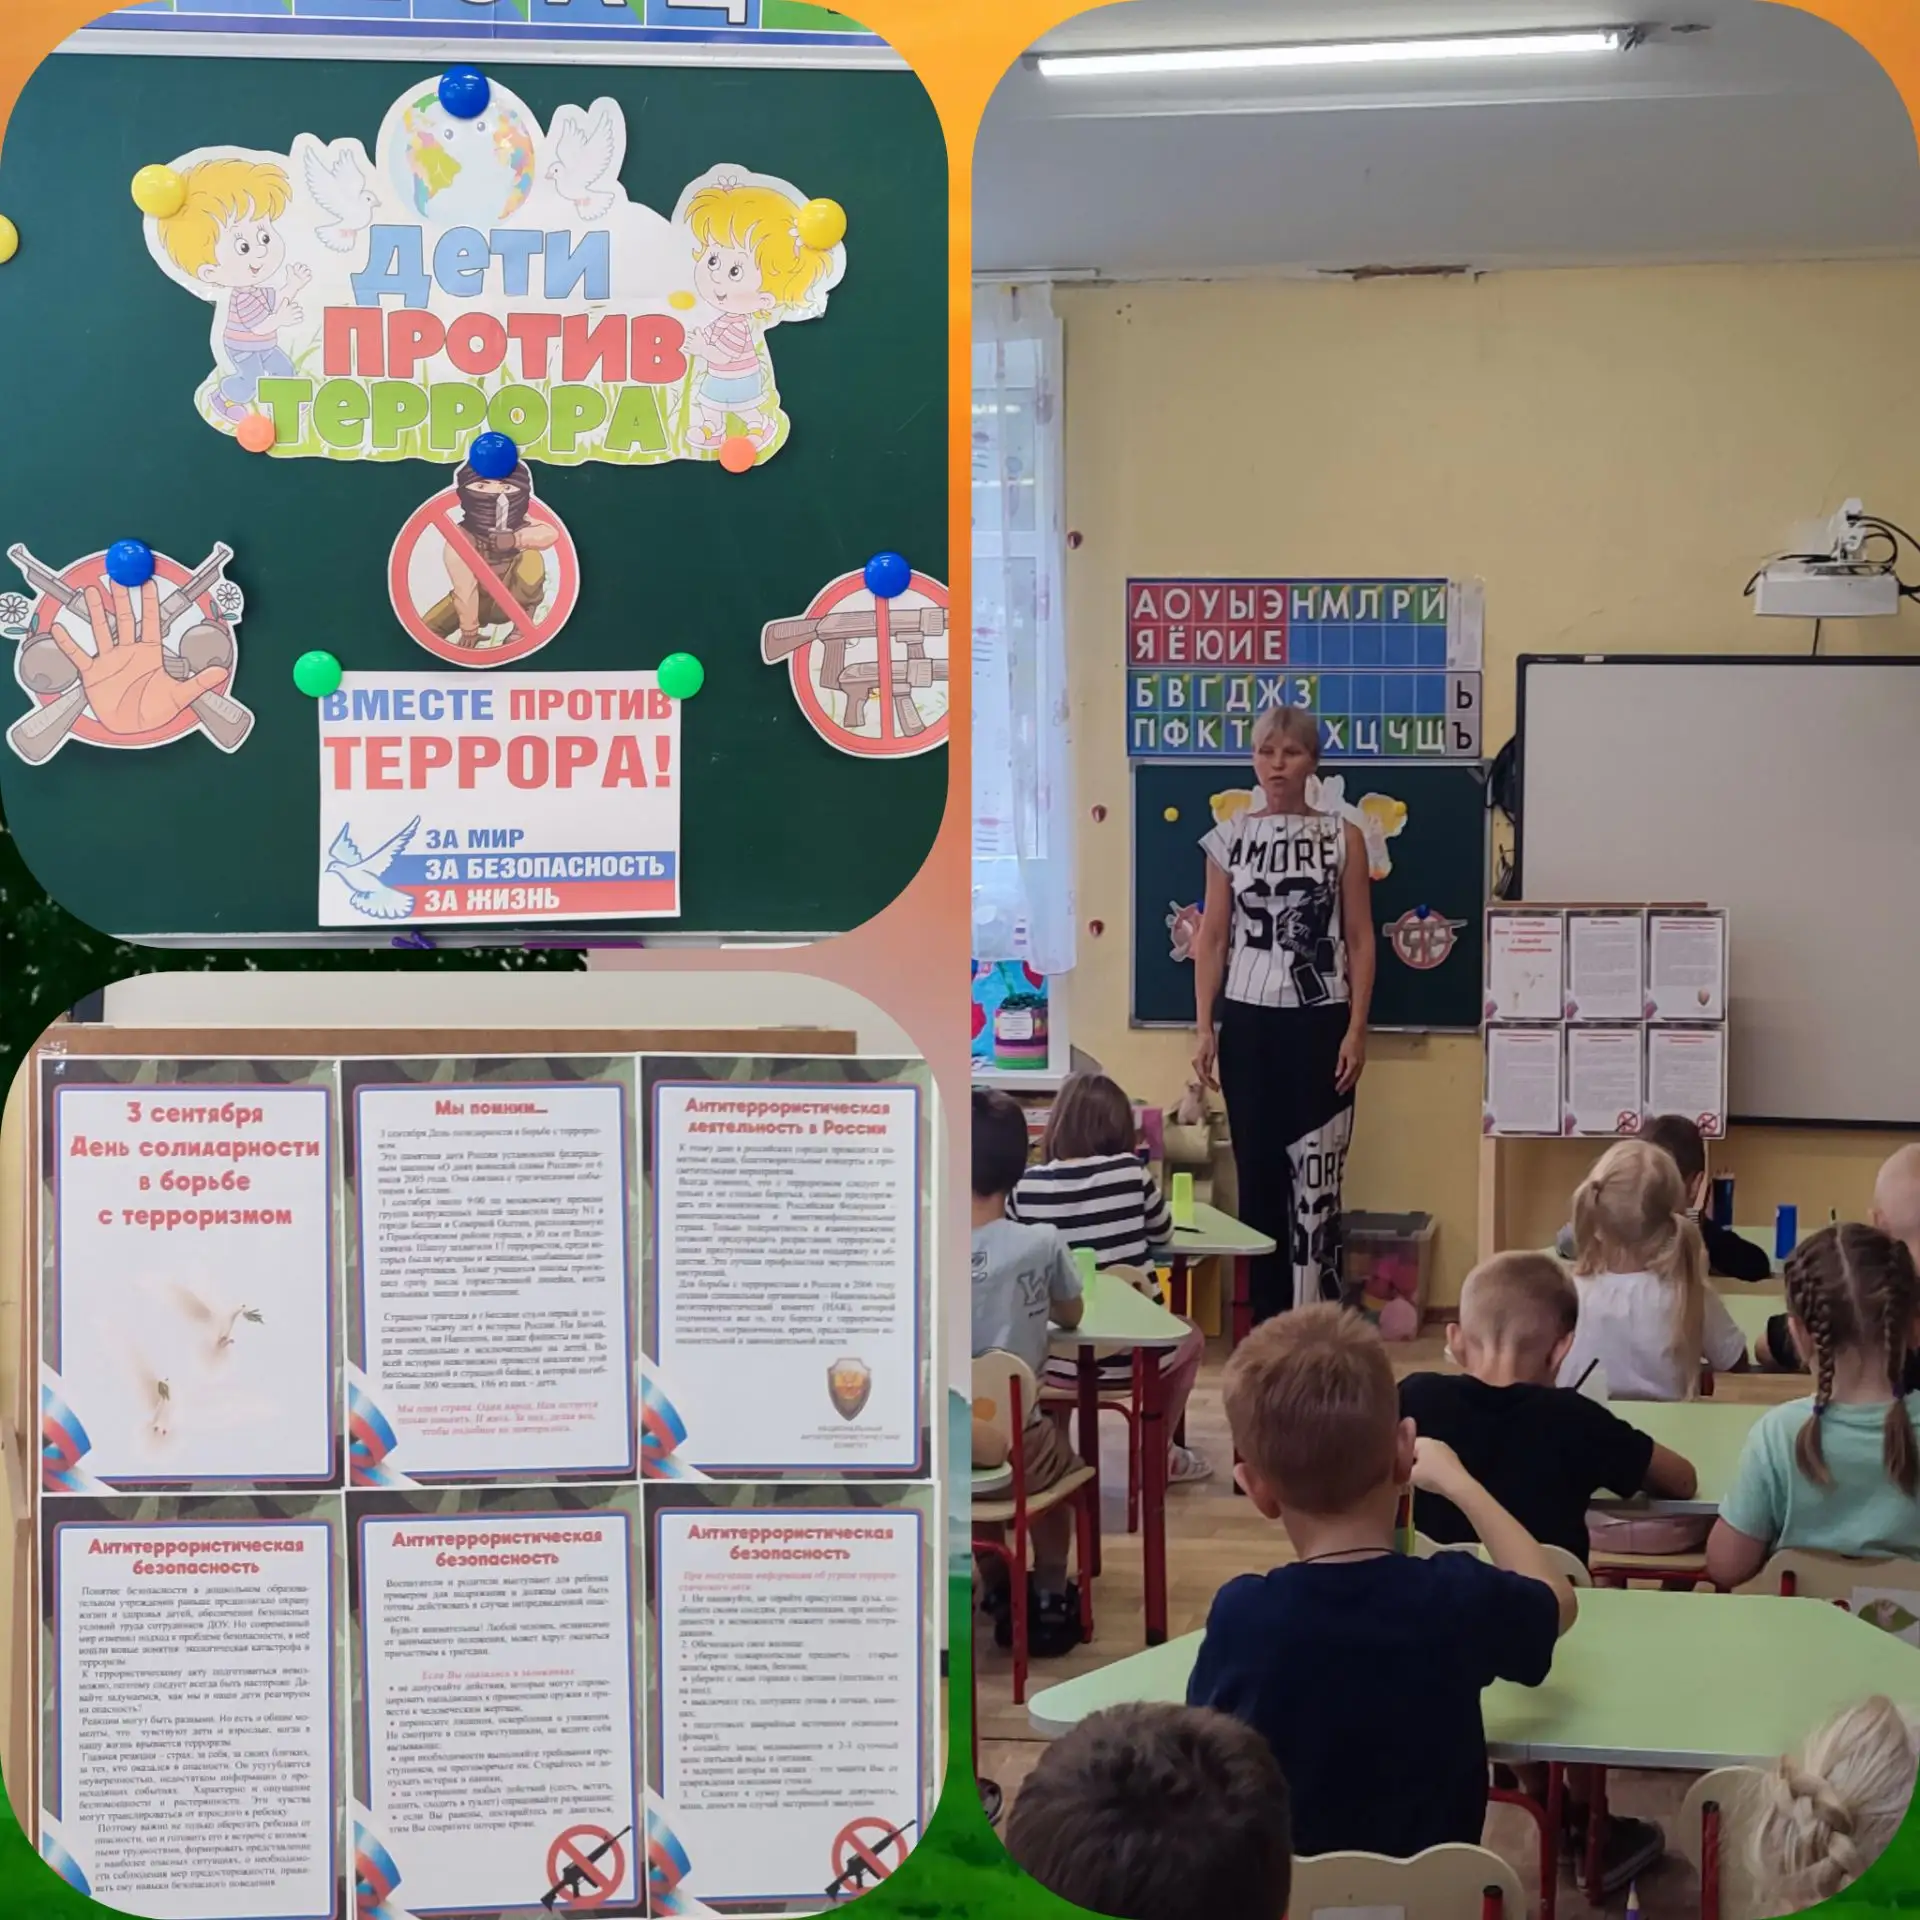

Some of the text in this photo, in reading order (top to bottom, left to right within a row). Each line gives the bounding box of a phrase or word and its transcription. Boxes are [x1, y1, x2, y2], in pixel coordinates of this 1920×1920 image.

[323, 689, 672, 721] ВМЕСТЕ ПРОТИВ
[324, 735, 671, 790] ТЕРРОРА!
[426, 829, 524, 849] ЗА МИР
[1229, 837, 1334, 874] AMORE
[425, 855, 665, 880] ЗА БЕЗОПАСНОСТЬ
[424, 887, 560, 912] ЗА ЖИЗНЬ
[127, 1102, 263, 1128] 3 сентября
[435, 1100, 464, 1116] Мы
[685, 1099, 890, 1118] Антитеррористическая
[808, 1123, 818, 1135] в
[824, 1120, 887, 1136] России
[71, 1136, 320, 1162] День солидарности
[139, 1170, 250, 1196] в борьбе
[99, 1209, 292, 1230] с терроризмом
[392, 1529, 603, 1549] Антитеррористическая
[687, 1524, 894, 1543] Антитеррористическая
[87, 1538, 304, 1558] Антитеррористическая
[730, 1545, 851, 1560] безопасность
[132, 1558, 260, 1575] безопасность
[435, 1551, 559, 1567] безопасность
